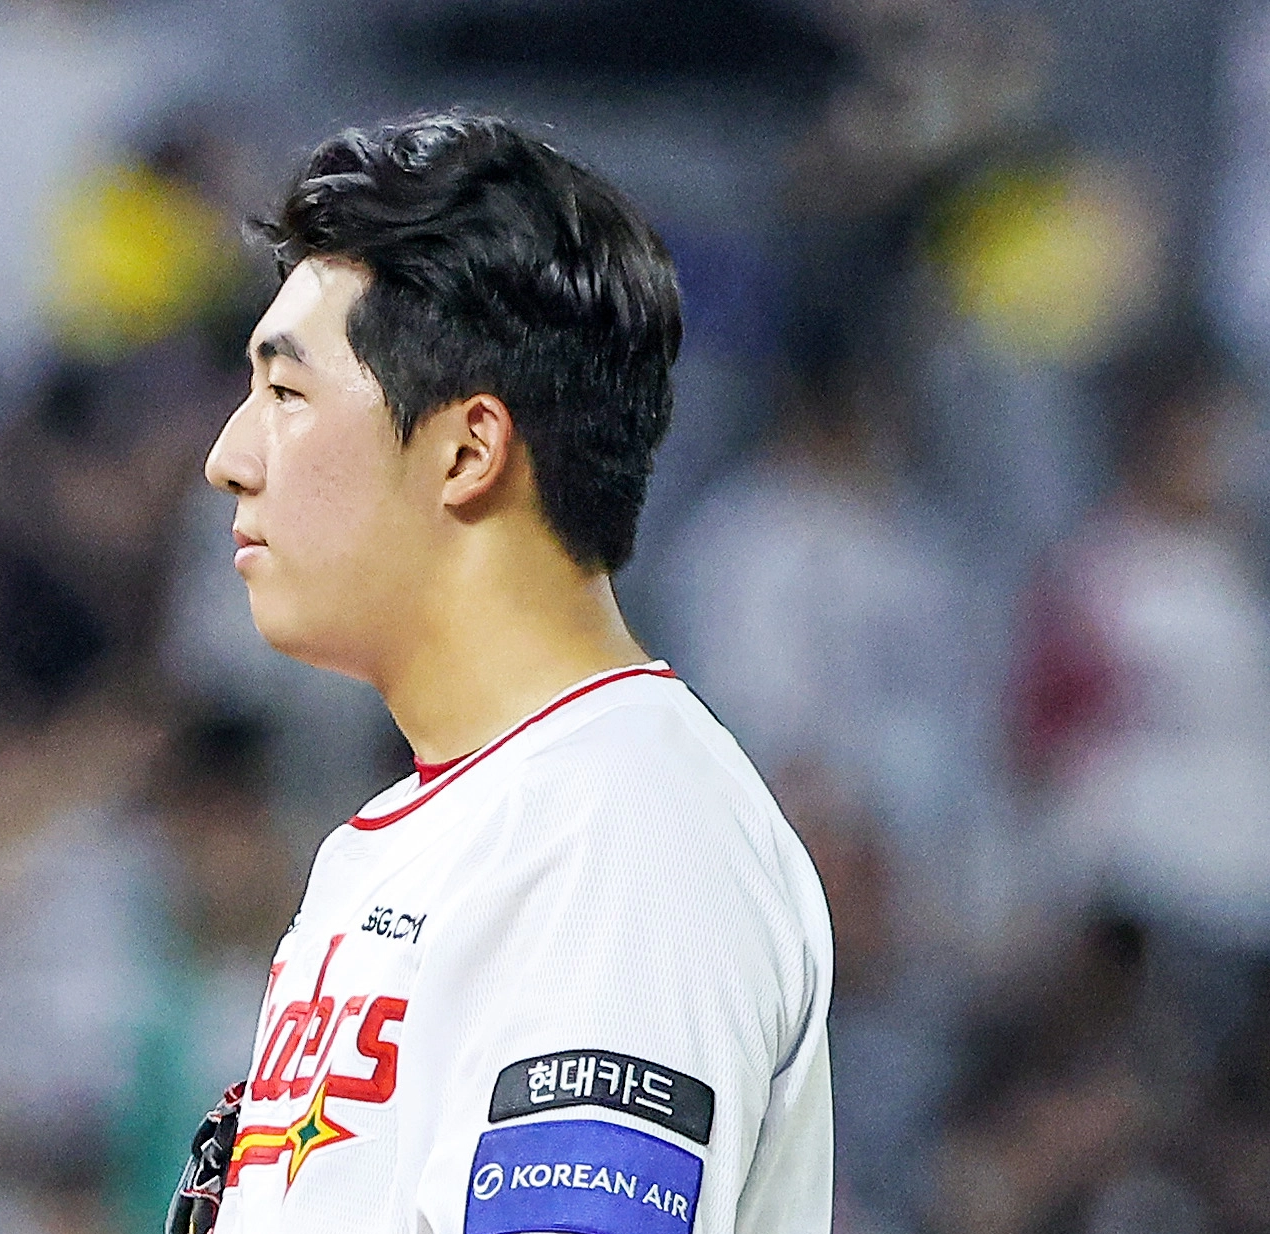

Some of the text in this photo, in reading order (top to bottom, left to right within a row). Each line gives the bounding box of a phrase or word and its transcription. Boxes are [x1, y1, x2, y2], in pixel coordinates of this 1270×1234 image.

[528, 1056, 674, 1116] 현대카드
[510, 1163, 688, 1222] KOREAN AIR
